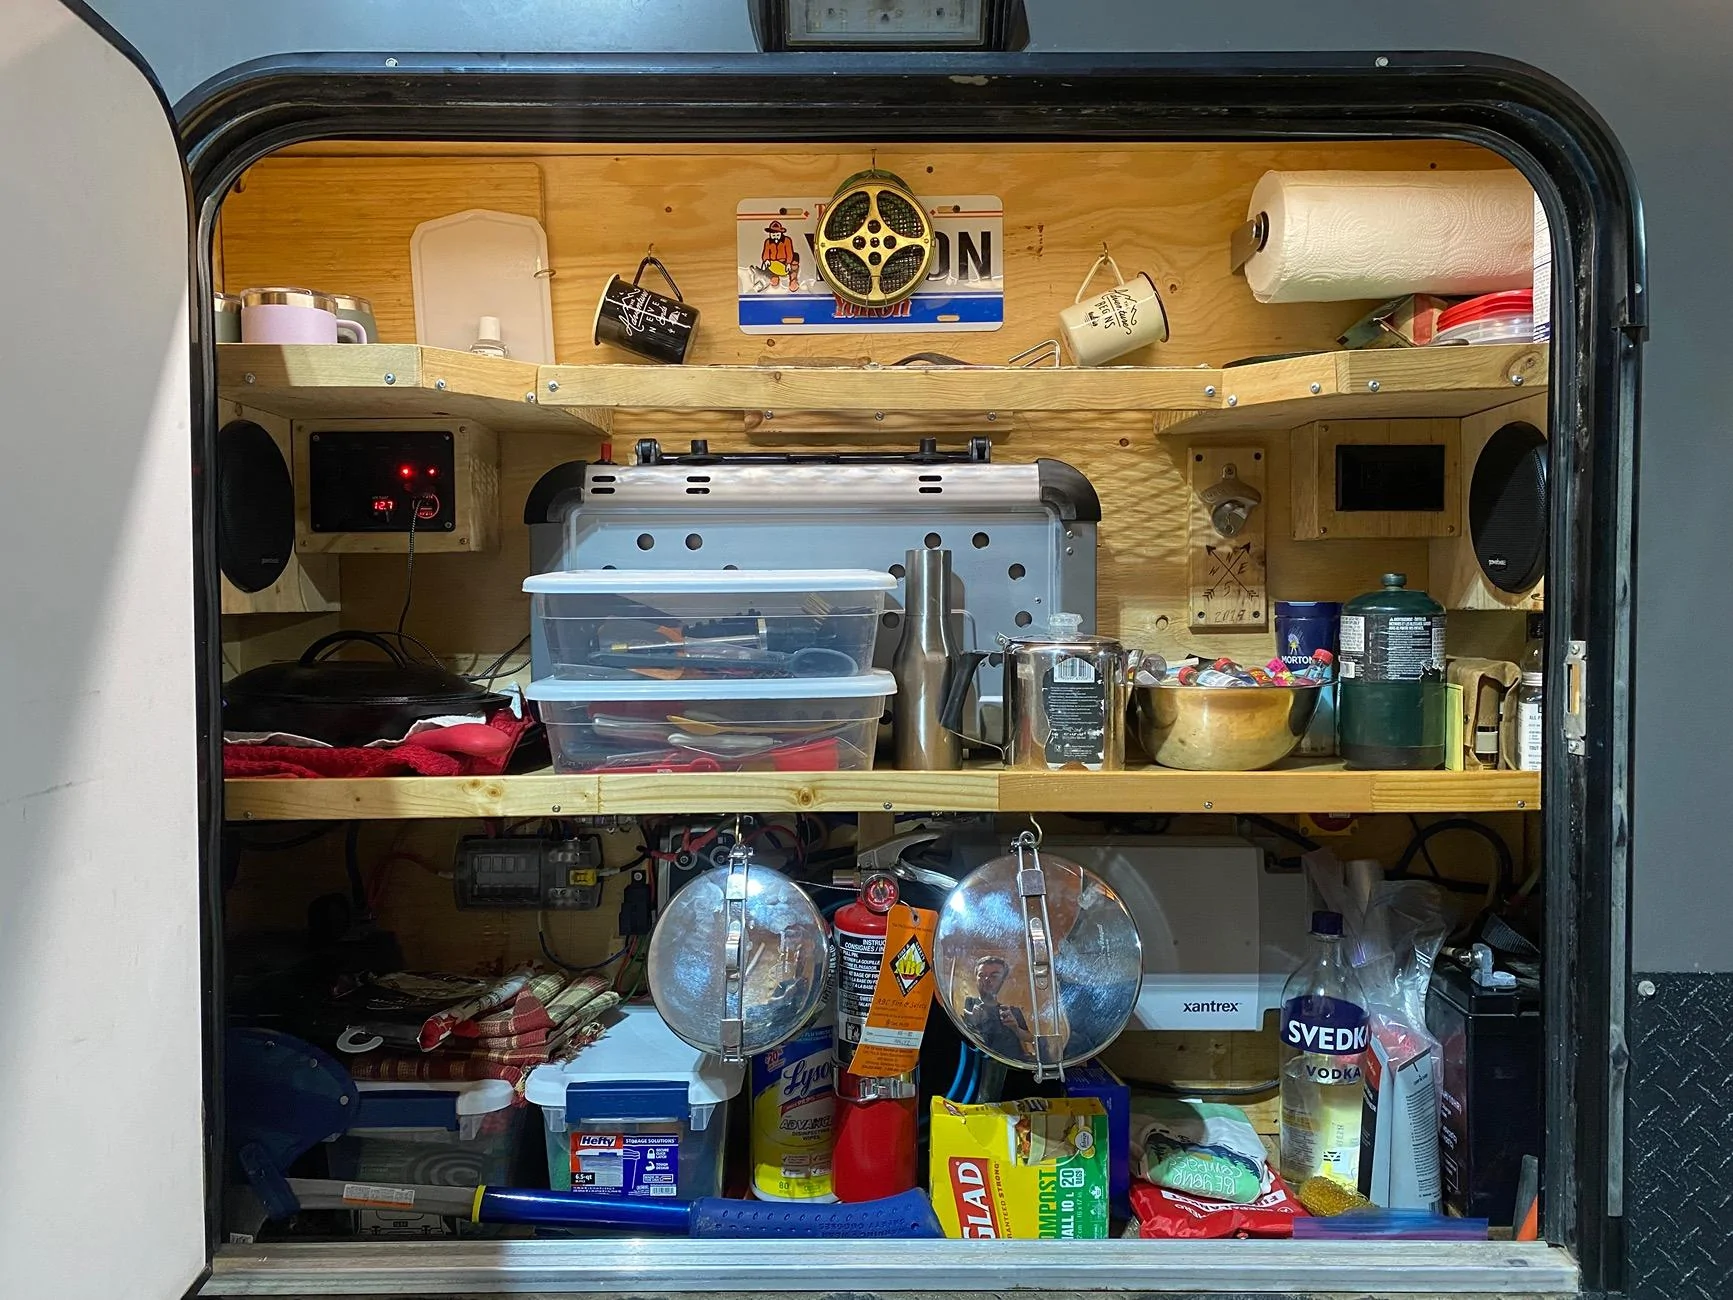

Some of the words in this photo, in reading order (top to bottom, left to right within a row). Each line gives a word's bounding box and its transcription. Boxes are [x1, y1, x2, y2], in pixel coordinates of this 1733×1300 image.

[1094, 300, 1116, 330] BEGNS
[373, 500, 393, 511] 12.7
[1183, 1000, 1239, 1012] xantrex
[1305, 1064, 1361, 1080] VODKA
[582, 1136, 615, 1147] Hefty
[575, 1173, 593, 1181] 6.5-qt
[1061, 1169, 1075, 1187] 20
[1214, 1175, 1237, 1196] BE
[957, 1162, 997, 1239] GLAD
[1061, 1214, 1075, 1239] ALL
